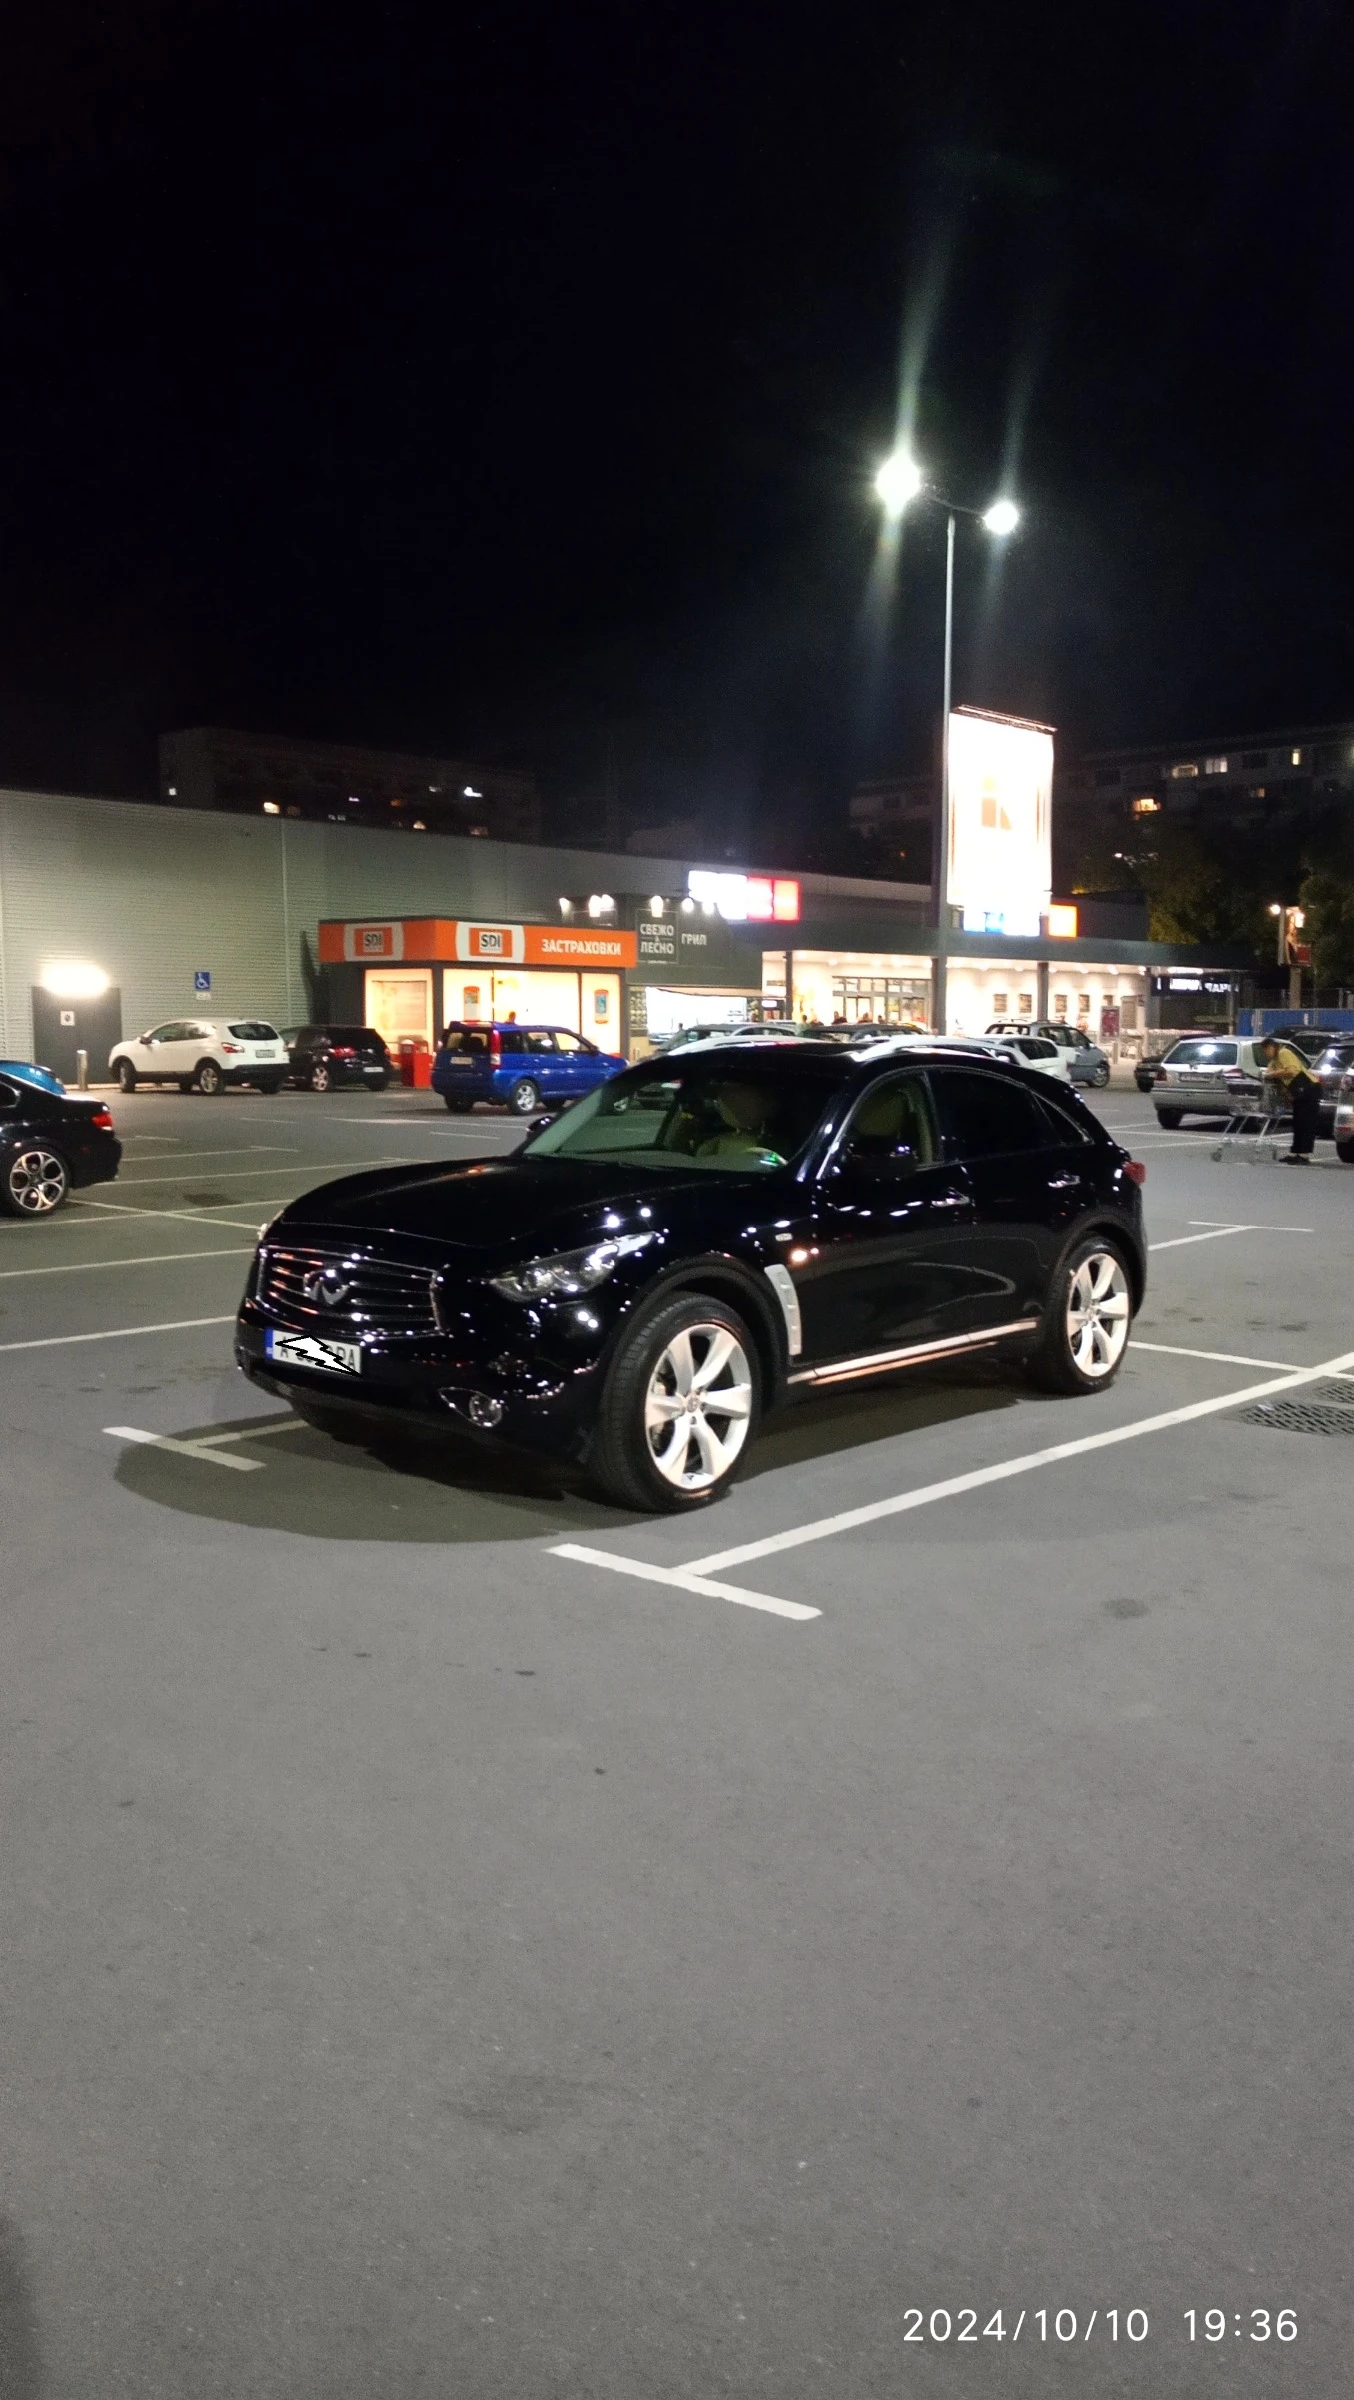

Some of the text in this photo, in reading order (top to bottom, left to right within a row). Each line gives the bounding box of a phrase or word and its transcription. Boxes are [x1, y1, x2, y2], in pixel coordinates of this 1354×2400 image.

[640, 923, 674, 936] СВЕЖО
[364, 933, 382, 947] SDI
[480, 934, 501, 948] SDI
[681, 933, 707, 946] ГРИЛ
[541, 938, 622, 956] ЗАСТРАХОВКИ
[640, 941, 674, 955] ЛЕСНО
